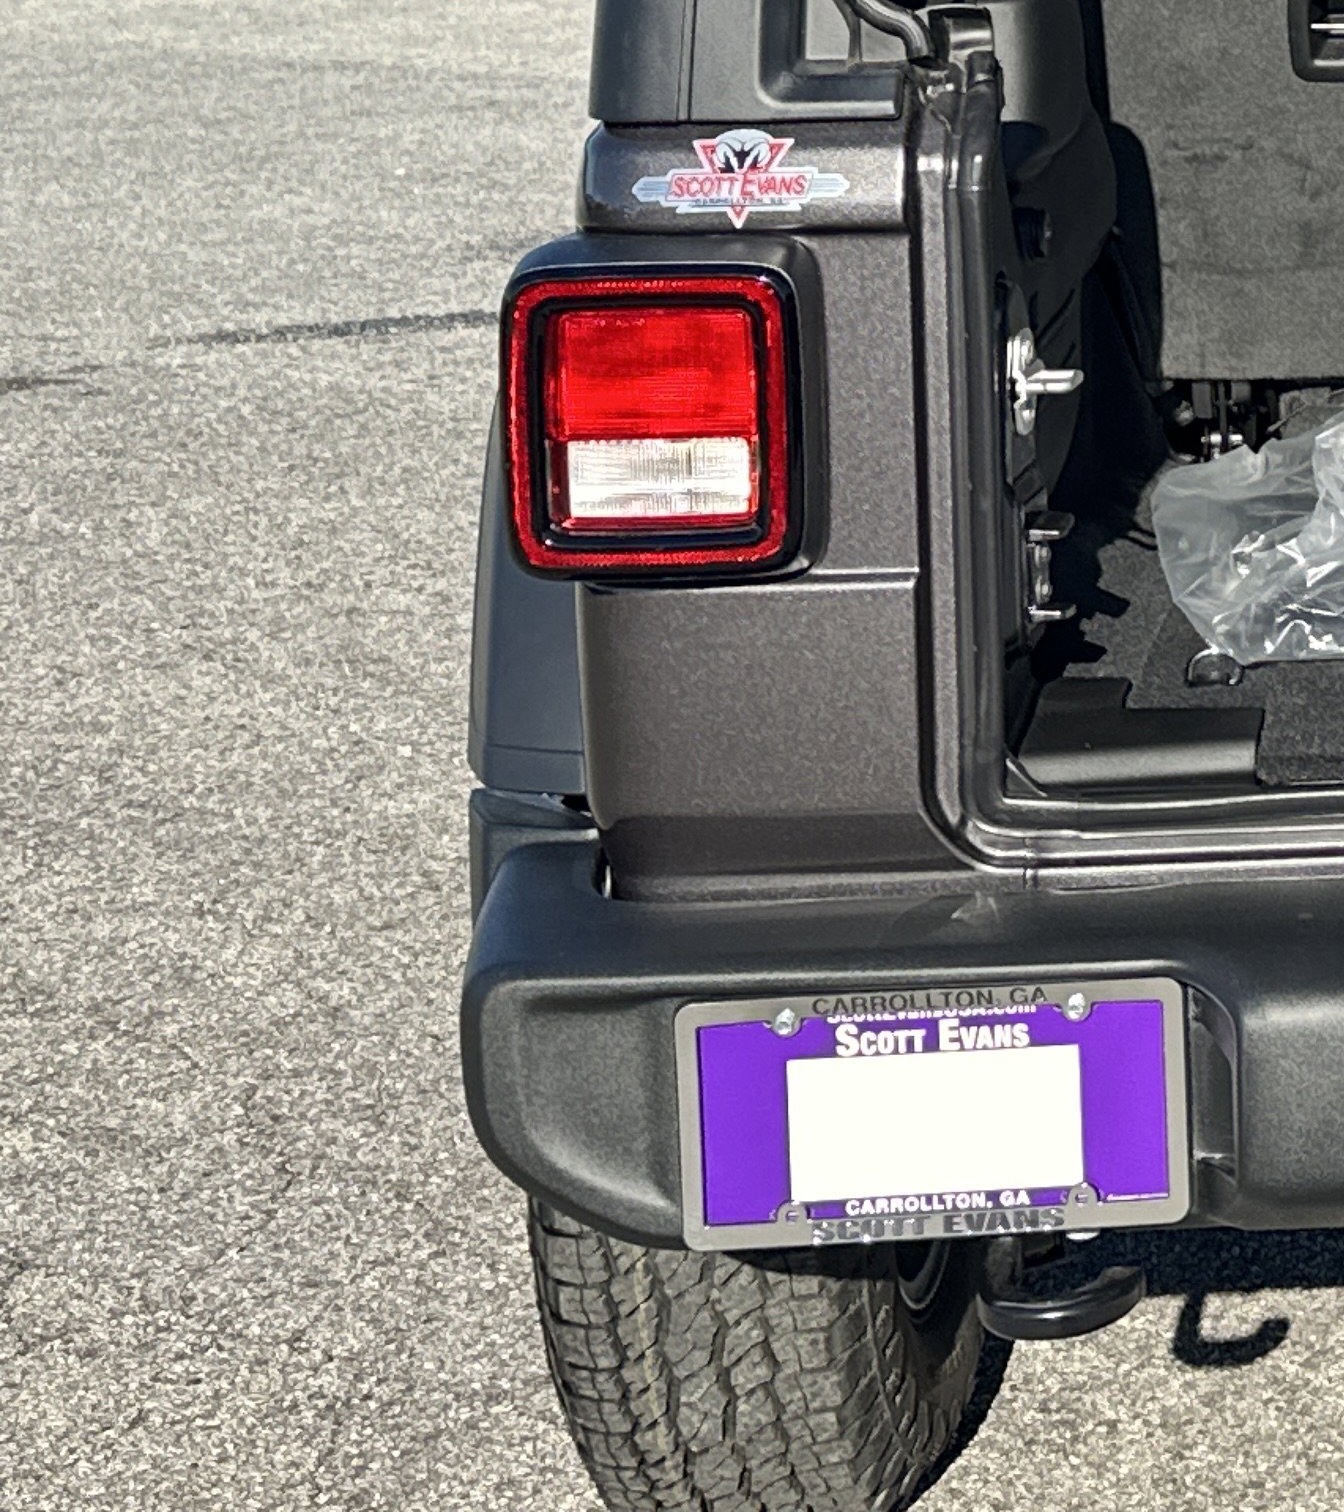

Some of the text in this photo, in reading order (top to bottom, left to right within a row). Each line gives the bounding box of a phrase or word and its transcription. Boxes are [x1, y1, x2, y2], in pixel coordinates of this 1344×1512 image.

[1009, 986, 1048, 1005] GA
[1000, 1190, 1031, 1207] GA
[813, 1208, 1065, 1244] SCOTT EVANS
